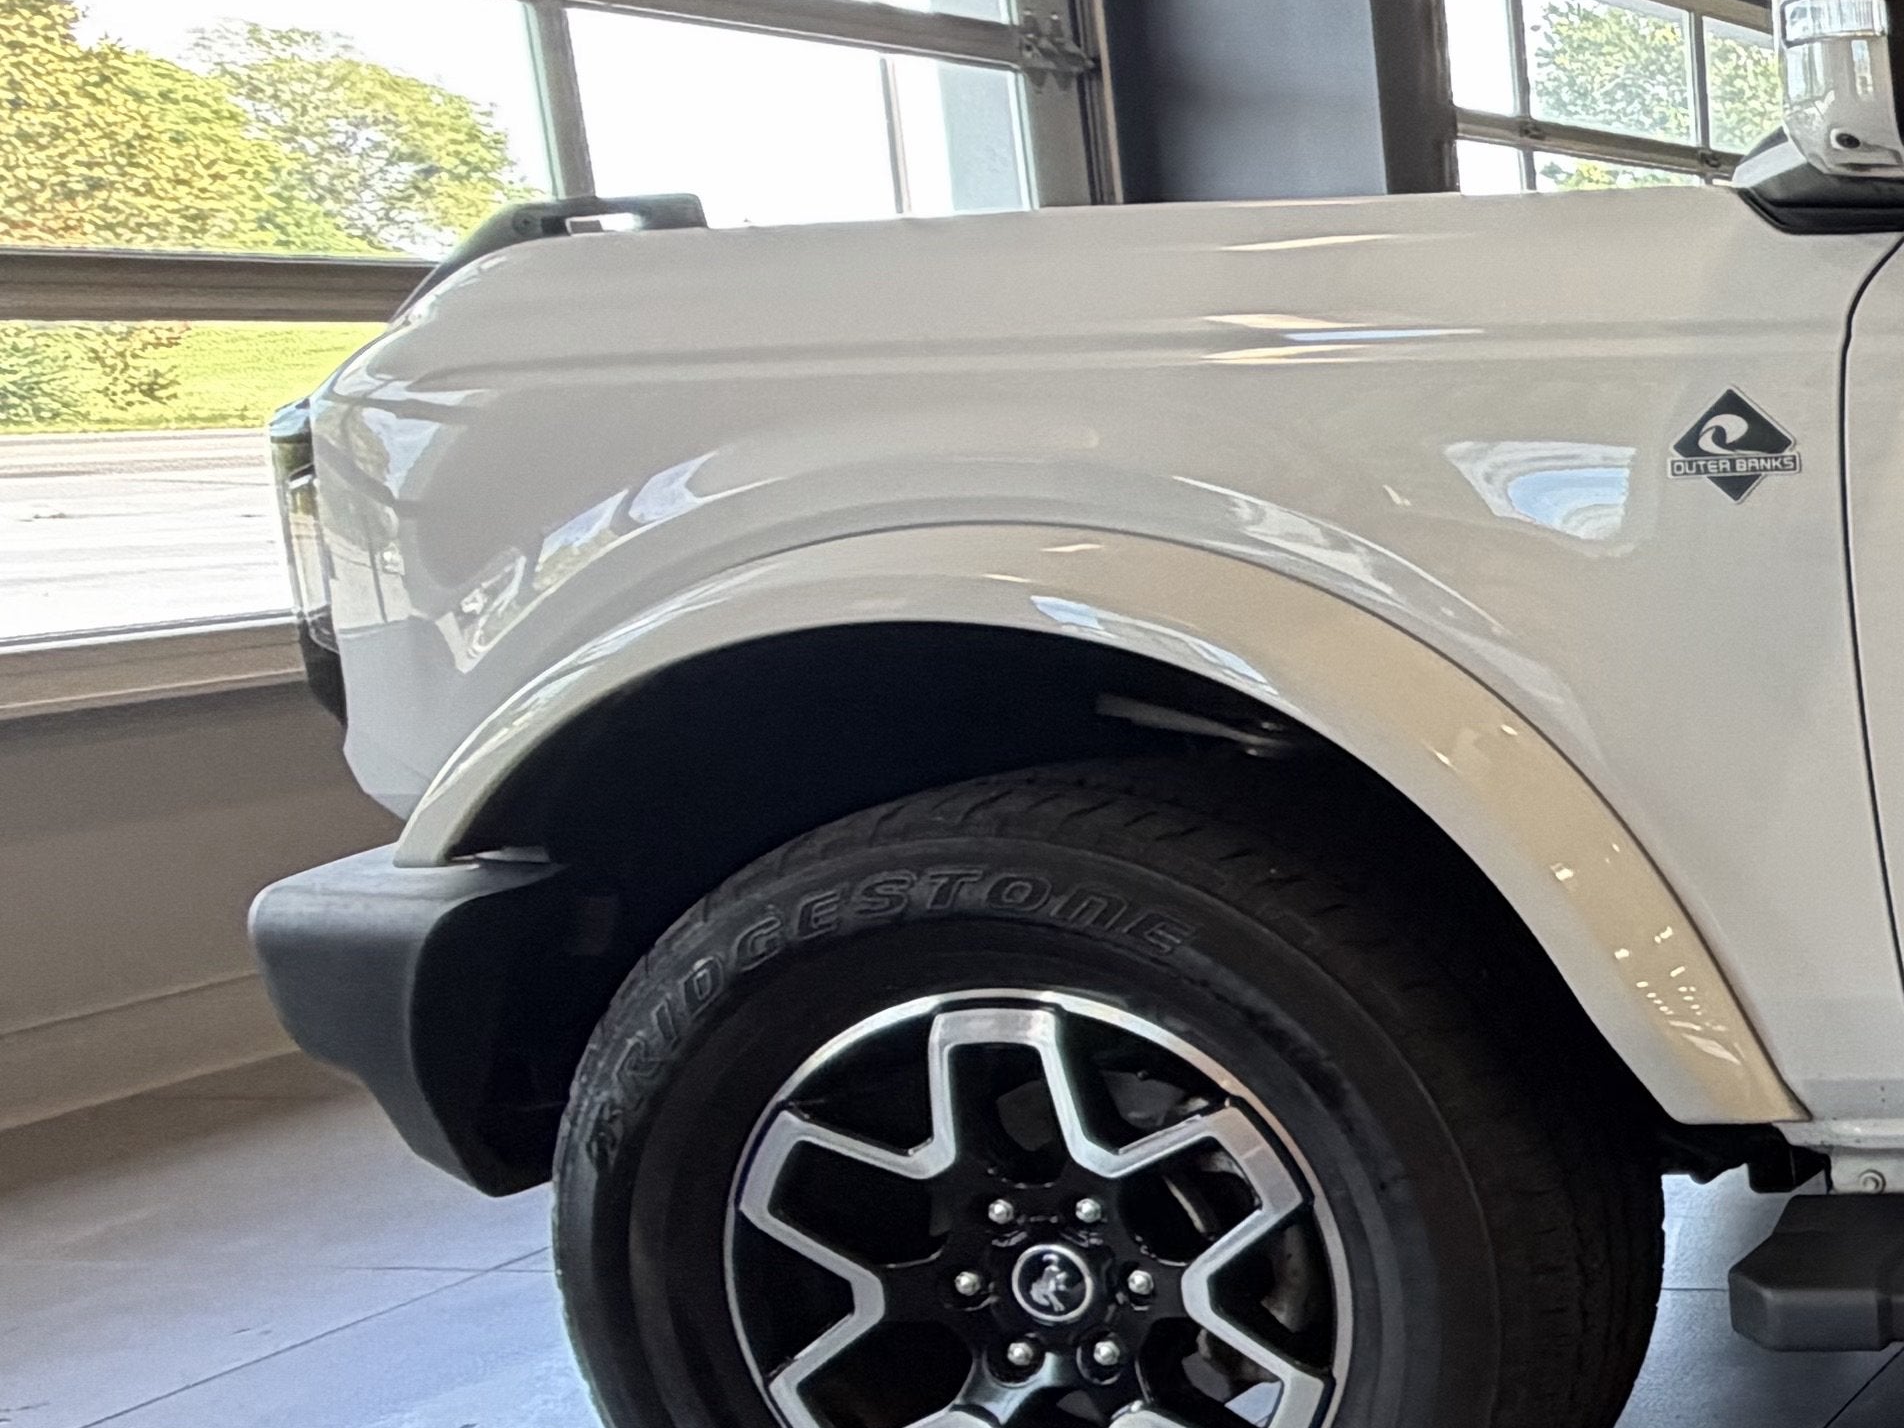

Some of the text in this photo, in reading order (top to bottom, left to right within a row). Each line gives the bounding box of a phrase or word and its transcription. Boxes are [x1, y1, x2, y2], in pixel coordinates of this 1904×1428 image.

[1673, 457, 1795, 475] OUTER BANKS
[586, 864, 1199, 1169] BRIDGESTONE
